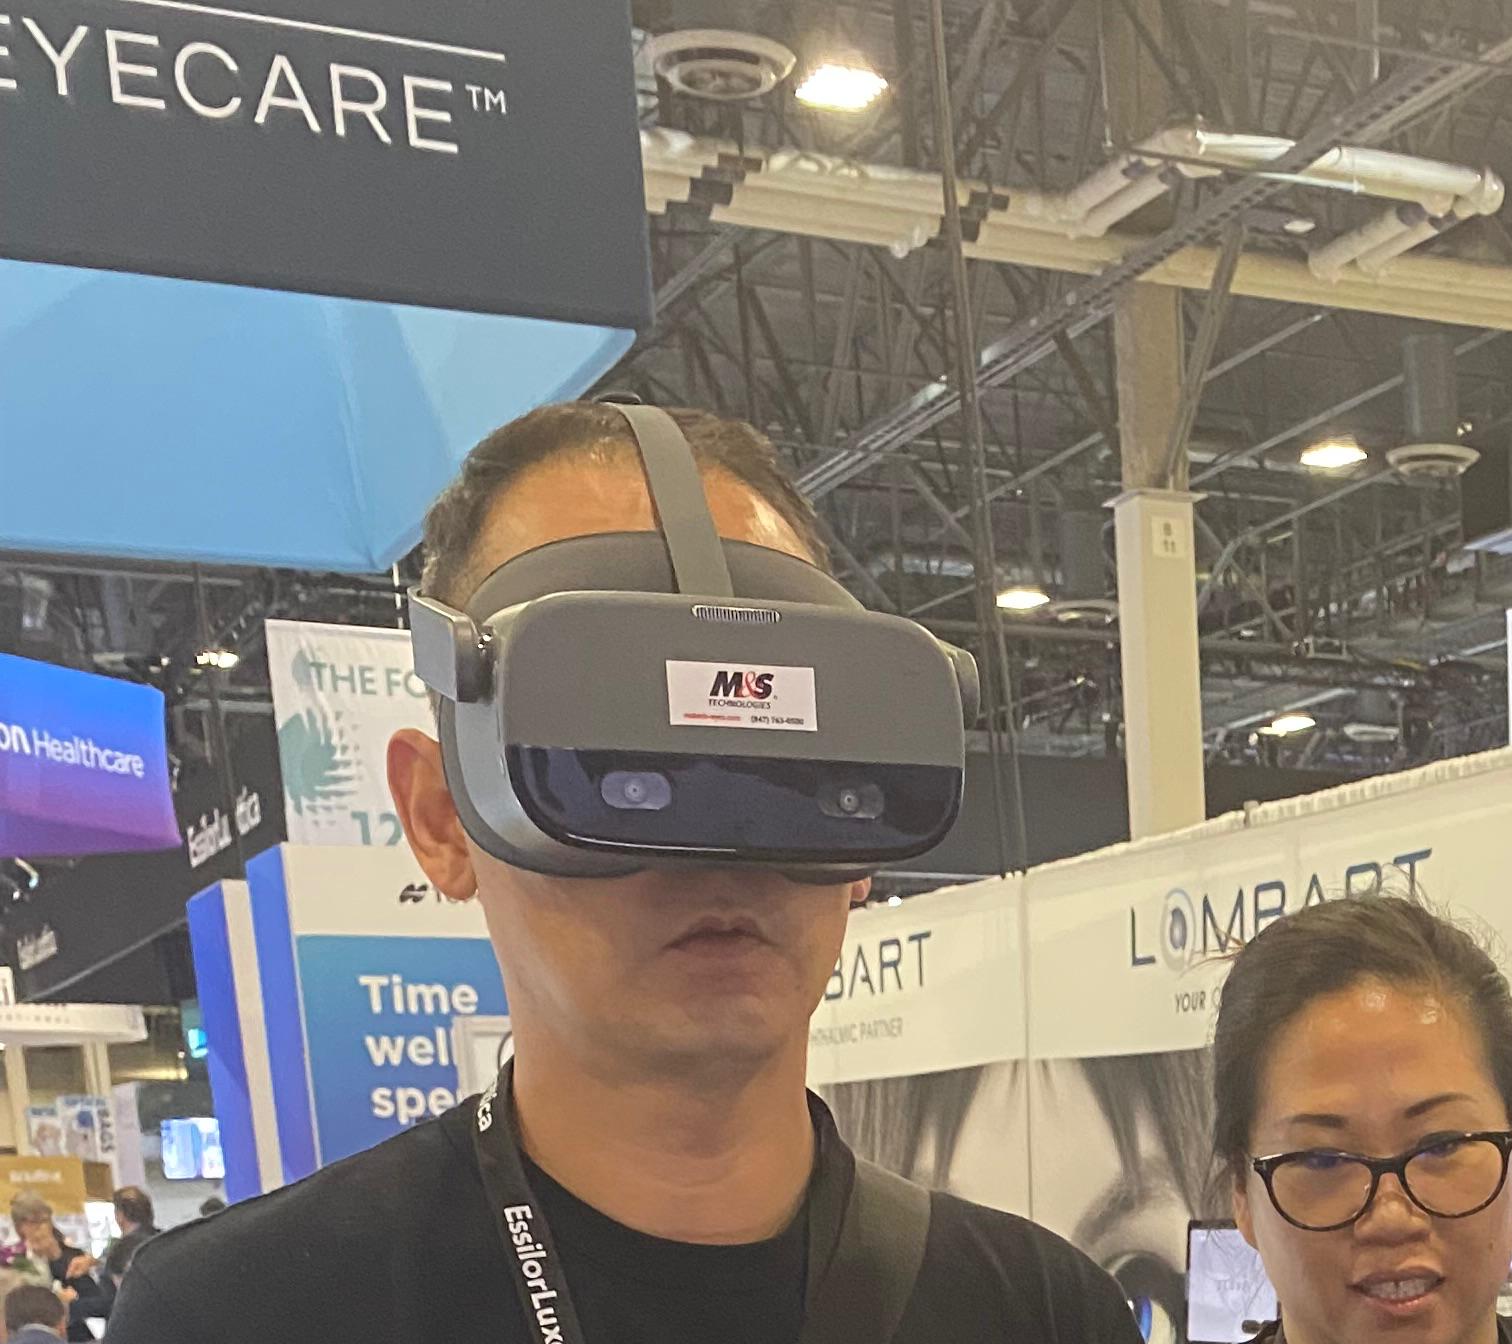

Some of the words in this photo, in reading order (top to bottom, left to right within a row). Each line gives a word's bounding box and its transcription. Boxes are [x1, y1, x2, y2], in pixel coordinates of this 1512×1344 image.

[310, 661, 377, 696] THE
[709, 671, 774, 700] M&S
[31, 728, 145, 778] Healthcare
[359, 974, 478, 1014] Time
[1175, 990, 1206, 1013] YOUR
